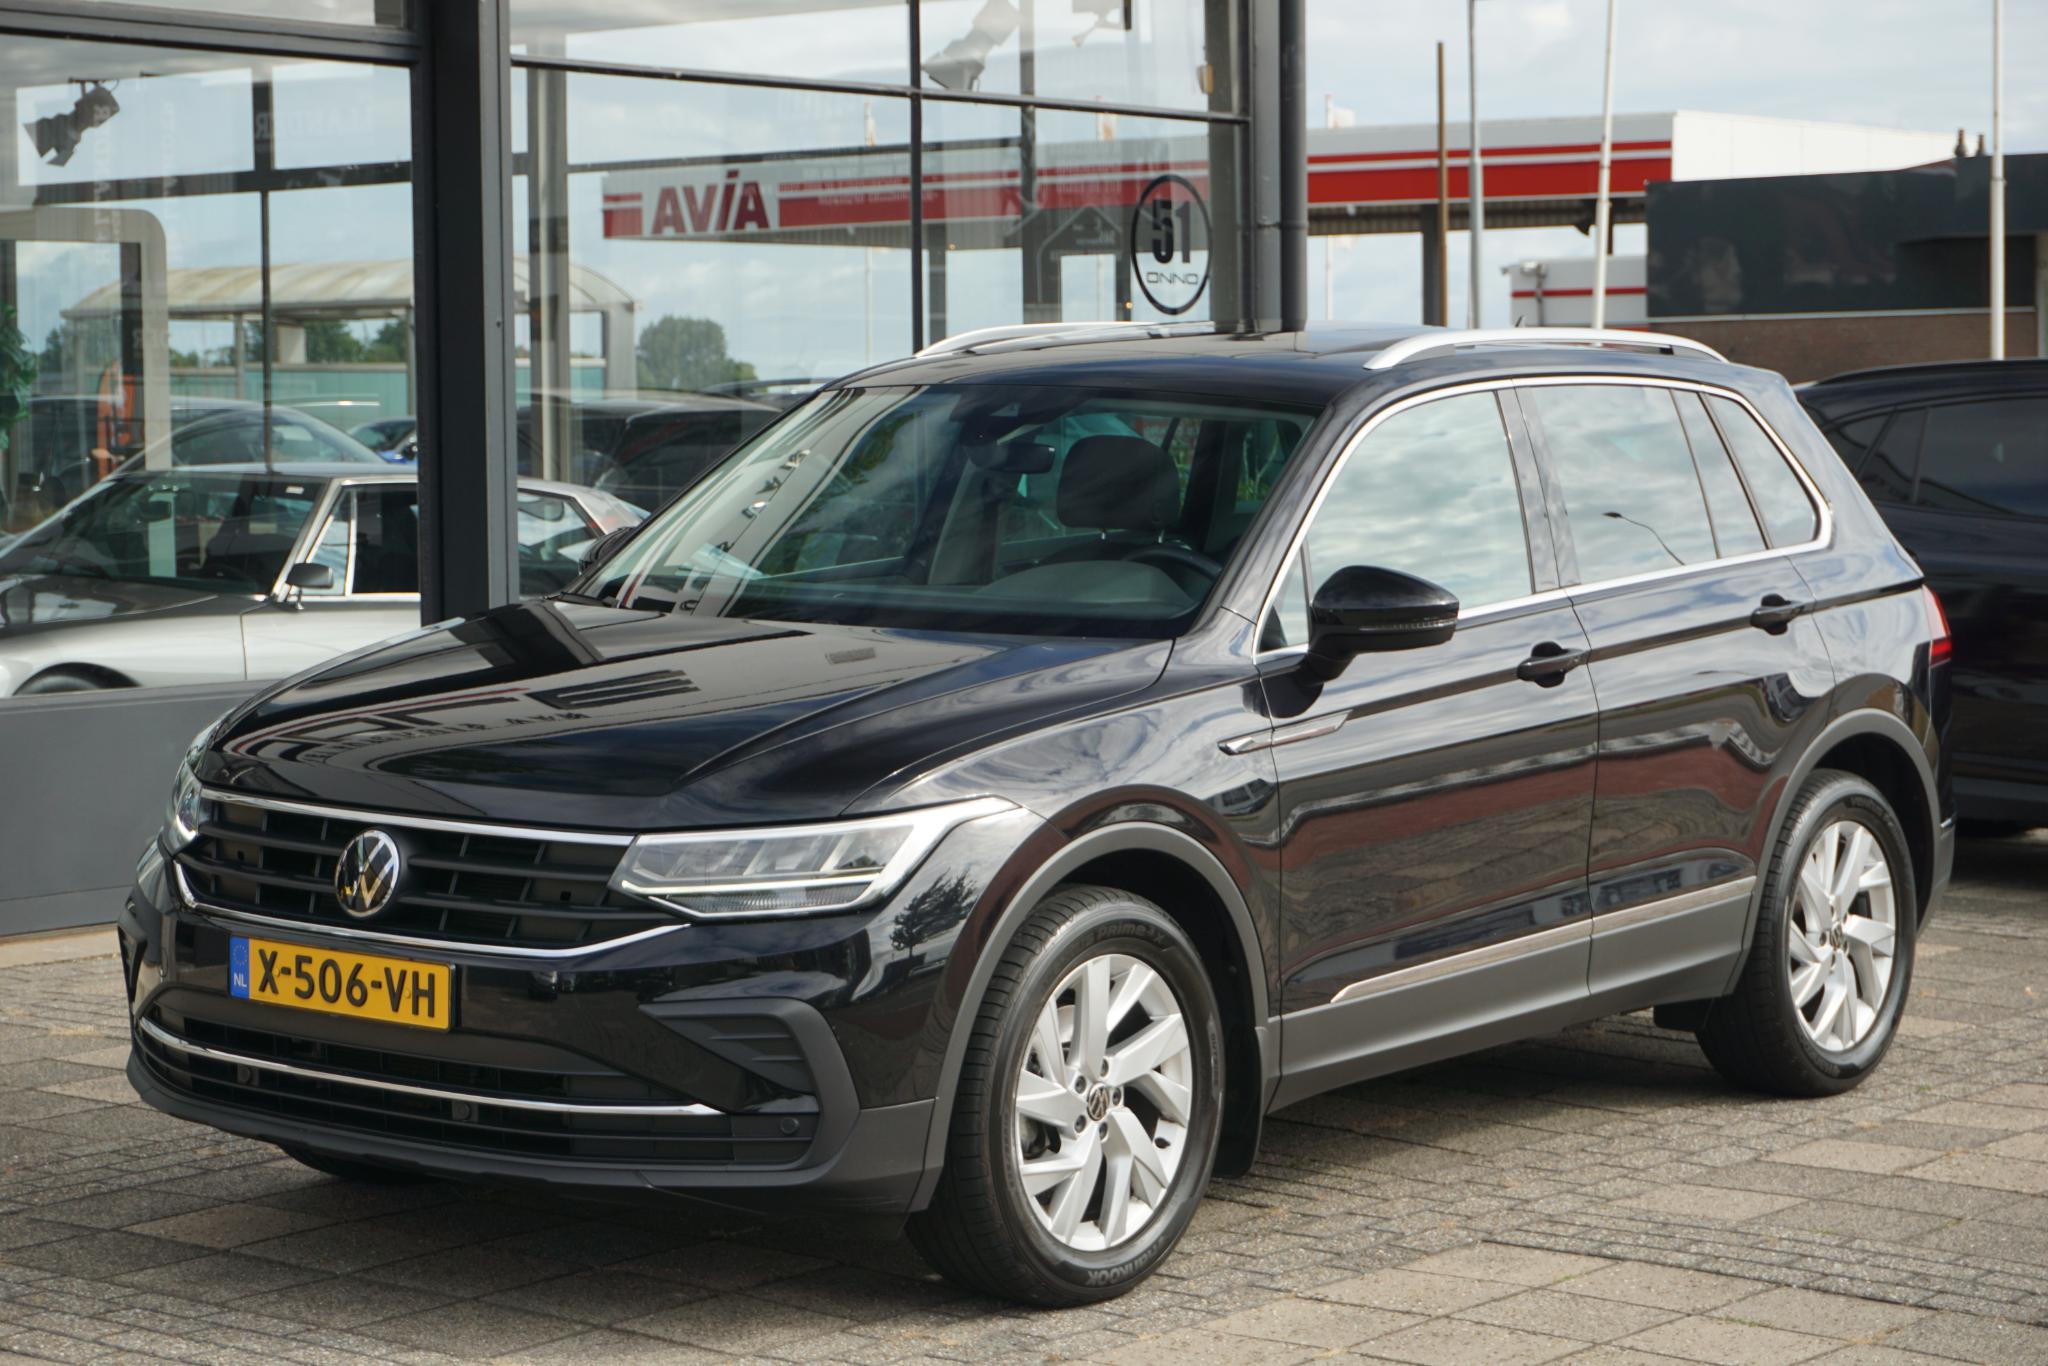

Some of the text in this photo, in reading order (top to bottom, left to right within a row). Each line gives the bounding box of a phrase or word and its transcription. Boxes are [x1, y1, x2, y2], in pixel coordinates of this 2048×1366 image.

[1151, 199, 1191, 264] 51
[233, 972, 248, 988] NL
[258, 948, 436, 1019] X-506-VH
